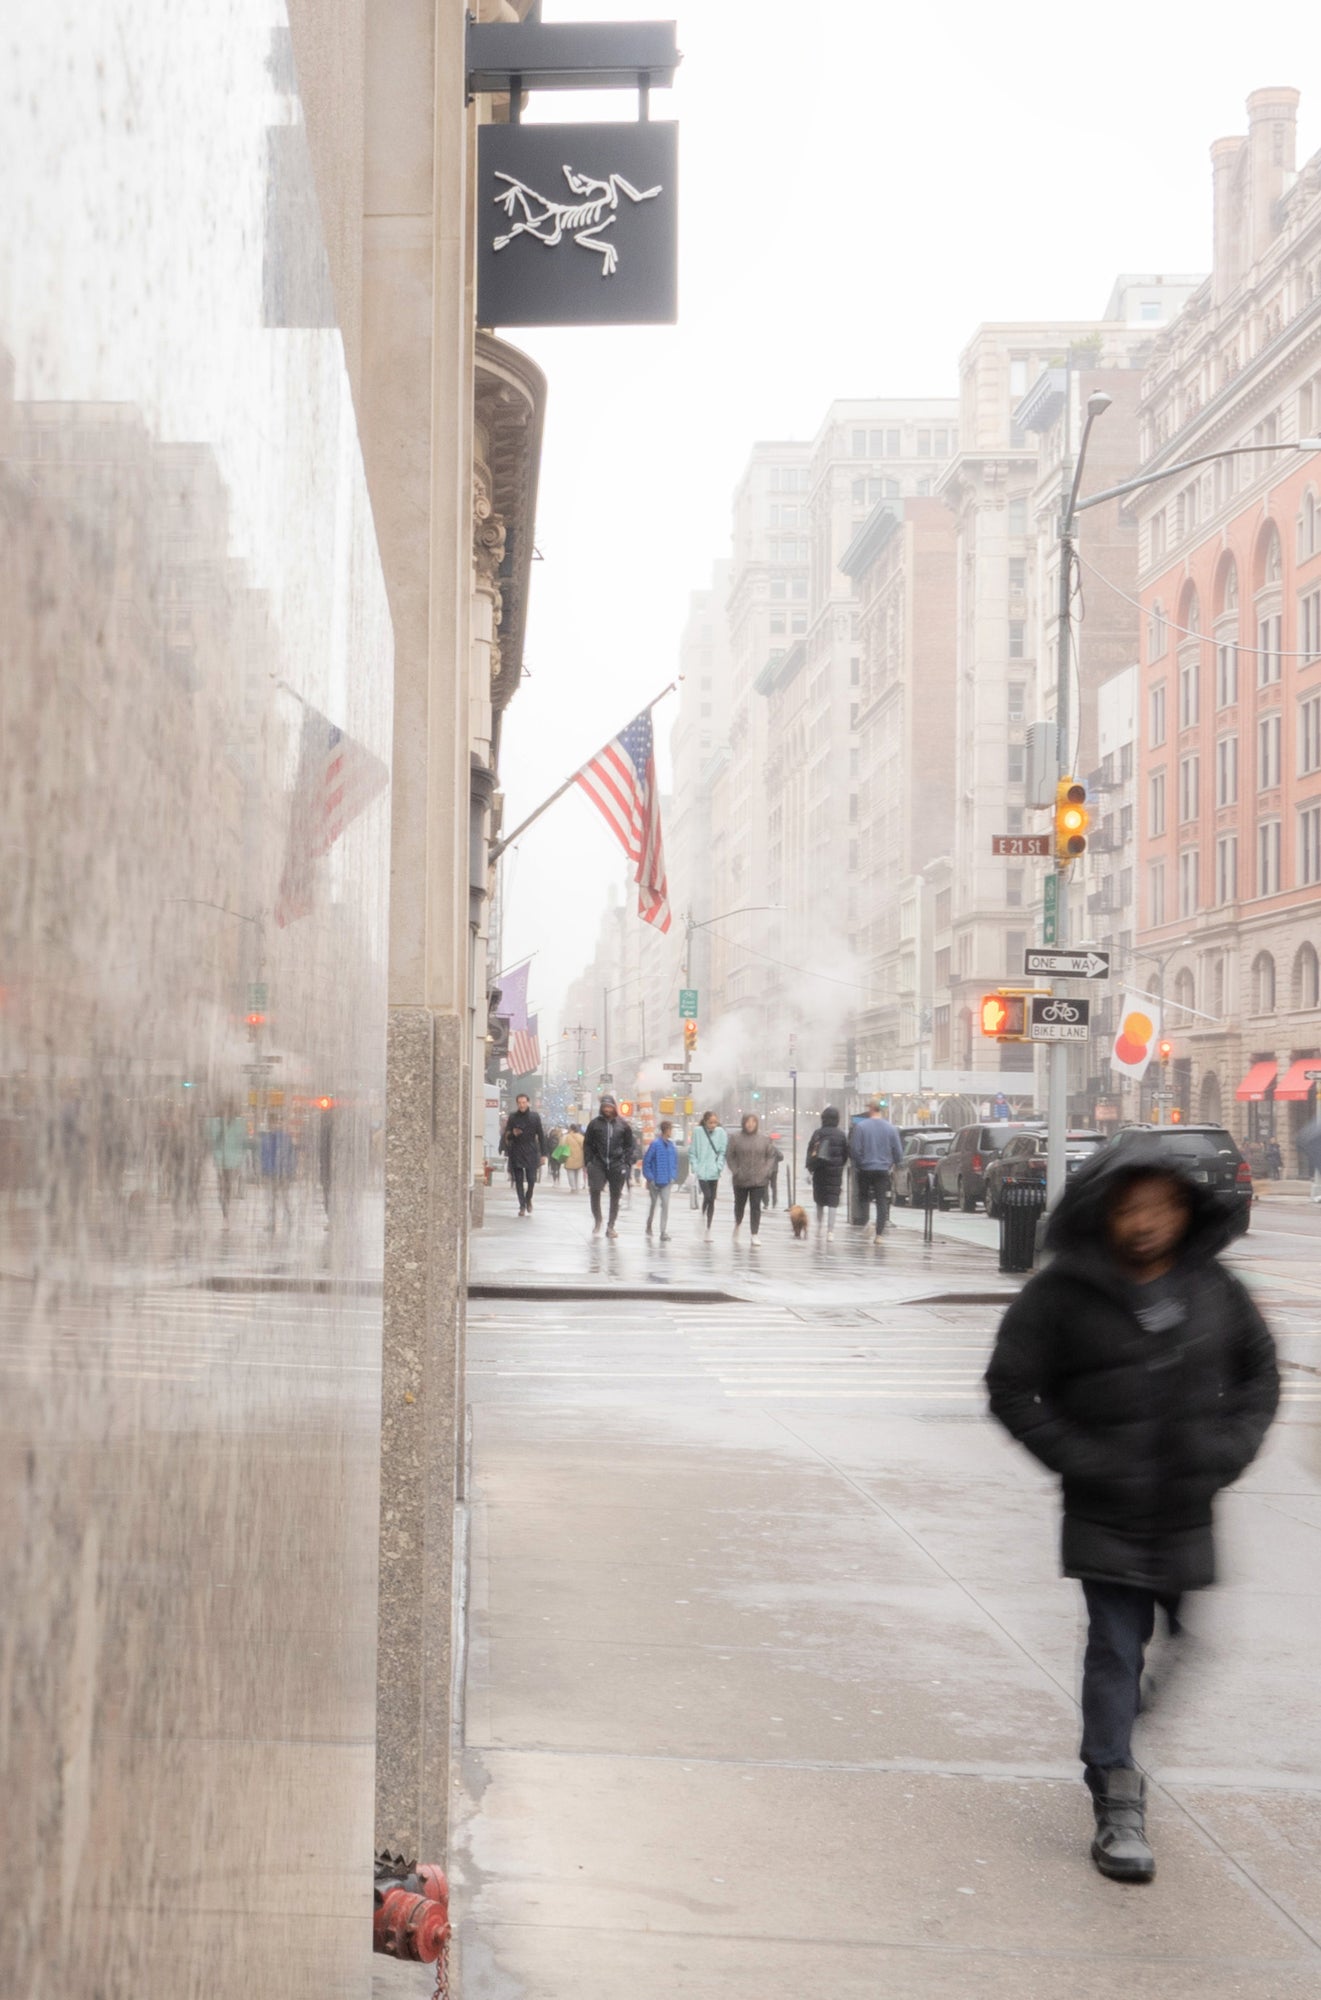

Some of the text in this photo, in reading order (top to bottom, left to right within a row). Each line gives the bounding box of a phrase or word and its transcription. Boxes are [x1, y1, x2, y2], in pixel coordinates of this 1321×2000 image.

[999, 840, 1041, 854] E 21 St
[1031, 957, 1098, 970] ONE WAY
[1033, 1025, 1086, 1038] BIKE LANE
